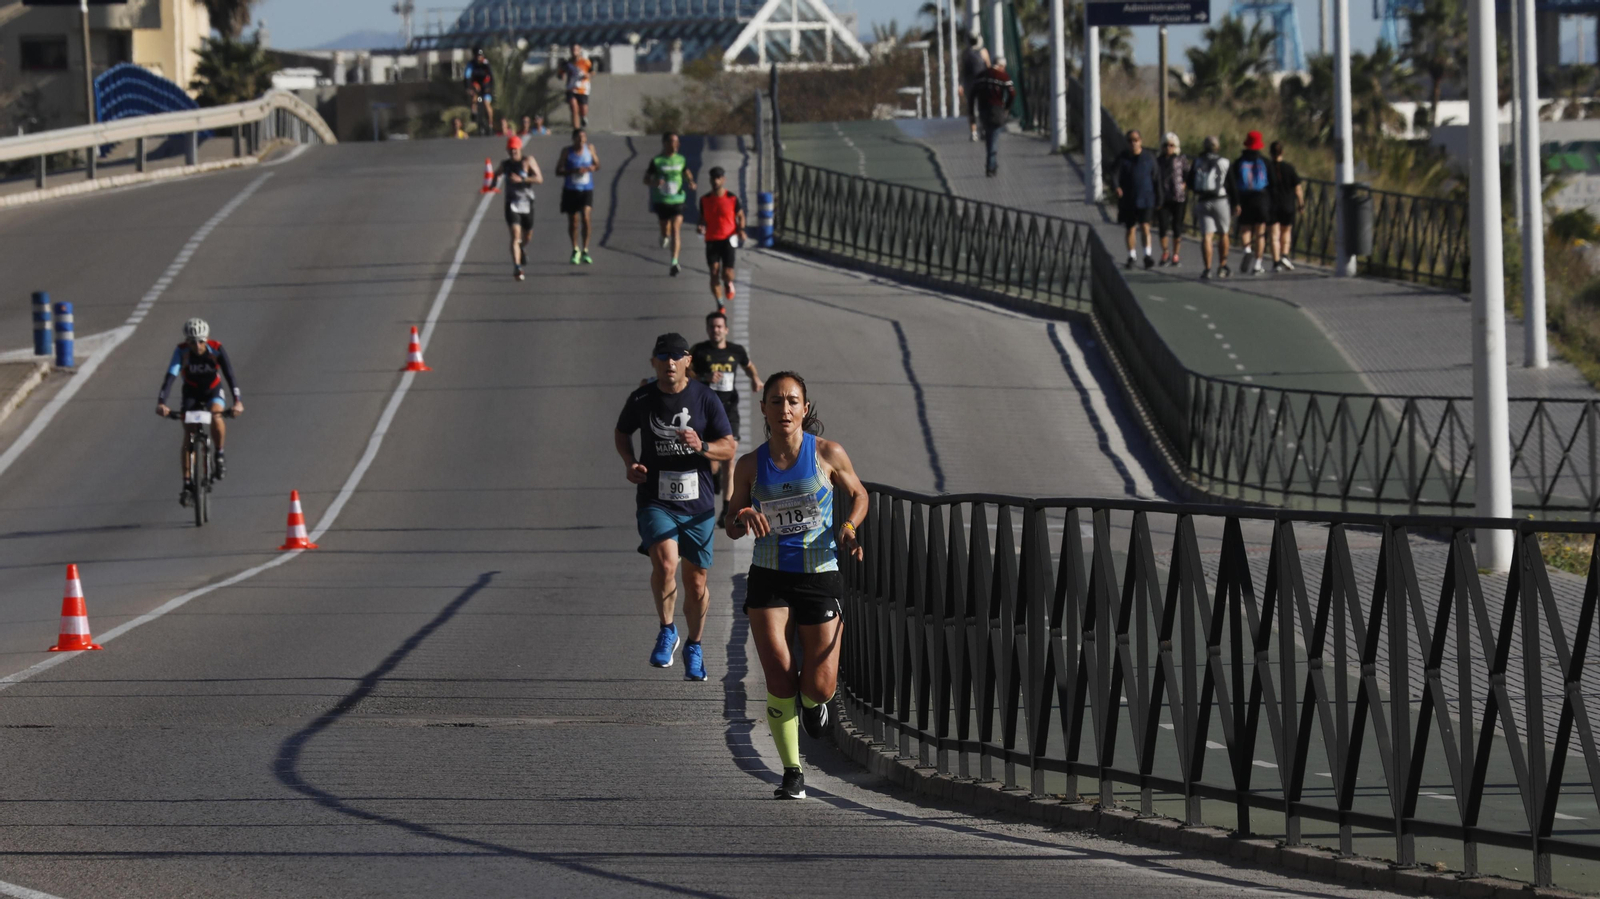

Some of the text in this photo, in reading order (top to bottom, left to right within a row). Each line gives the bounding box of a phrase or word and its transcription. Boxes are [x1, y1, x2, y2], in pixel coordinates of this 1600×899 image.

[1123, 3, 1191, 13] Administración
[670, 482, 684, 494] 90
[776, 509, 804, 526] 118
[781, 525, 809, 534] EVOS
